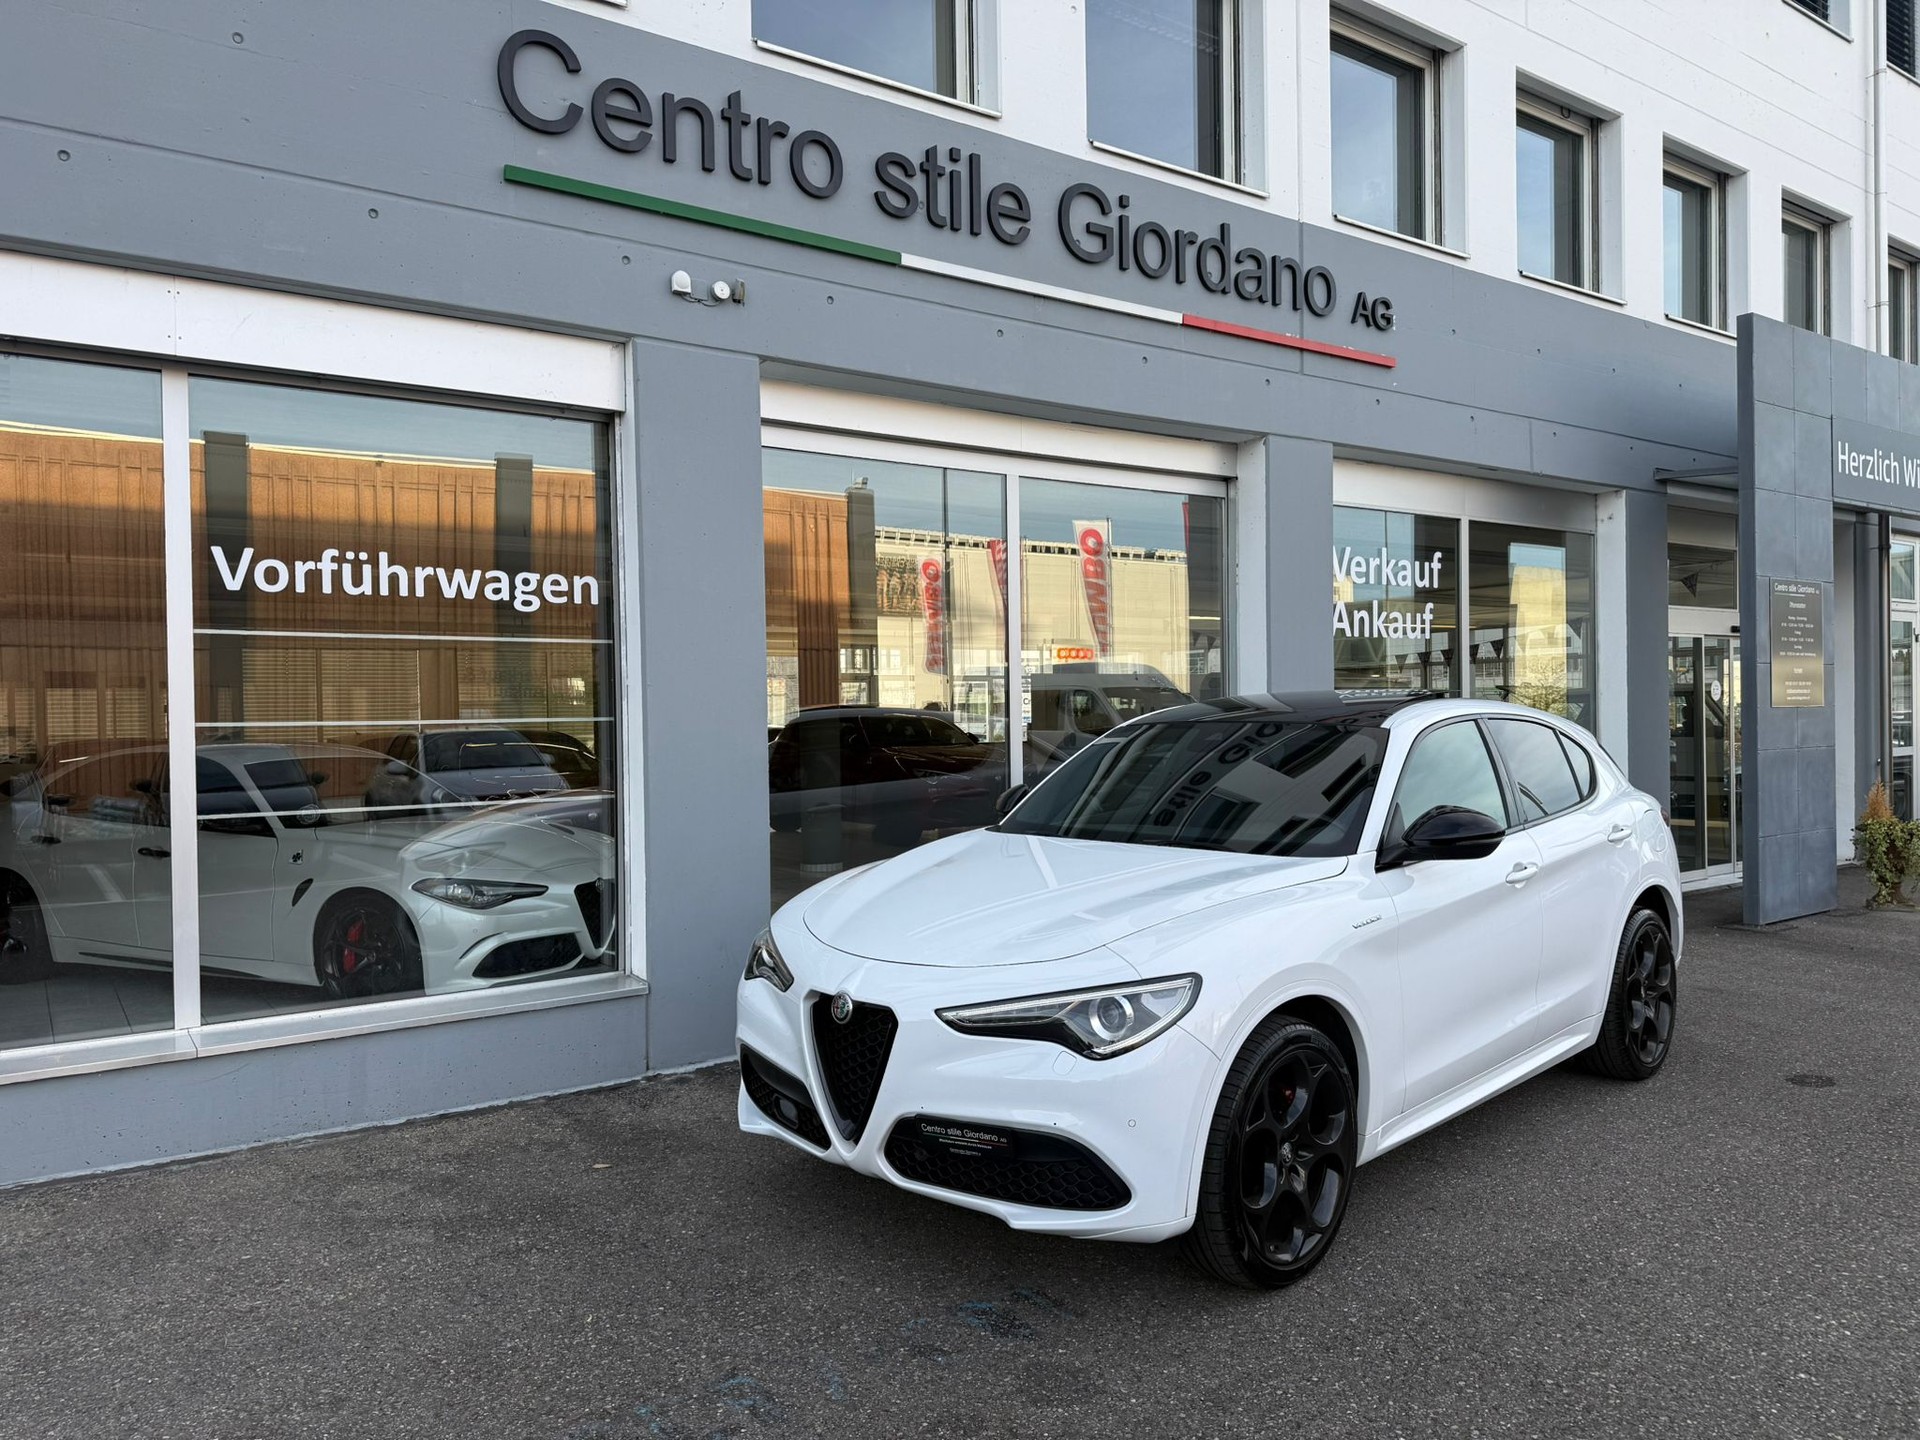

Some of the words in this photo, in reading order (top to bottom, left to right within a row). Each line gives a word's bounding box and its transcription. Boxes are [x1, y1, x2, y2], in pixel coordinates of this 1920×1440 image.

[498, 29, 844, 198] Centro
[873, 144, 1031, 246] stile
[1057, 182, 1337, 317] Giordano
[1351, 291, 1394, 331] AG
[1837, 441, 1900, 485] Herzlich
[210, 545, 600, 613] Vorführwagen
[1333, 545, 1442, 588] Verkauf
[1333, 600, 1434, 639] Ankauf
[921, 1123, 946, 1134] Centro
[947, 1127, 962, 1137] stile
[963, 1129, 998, 1142] Giordano
